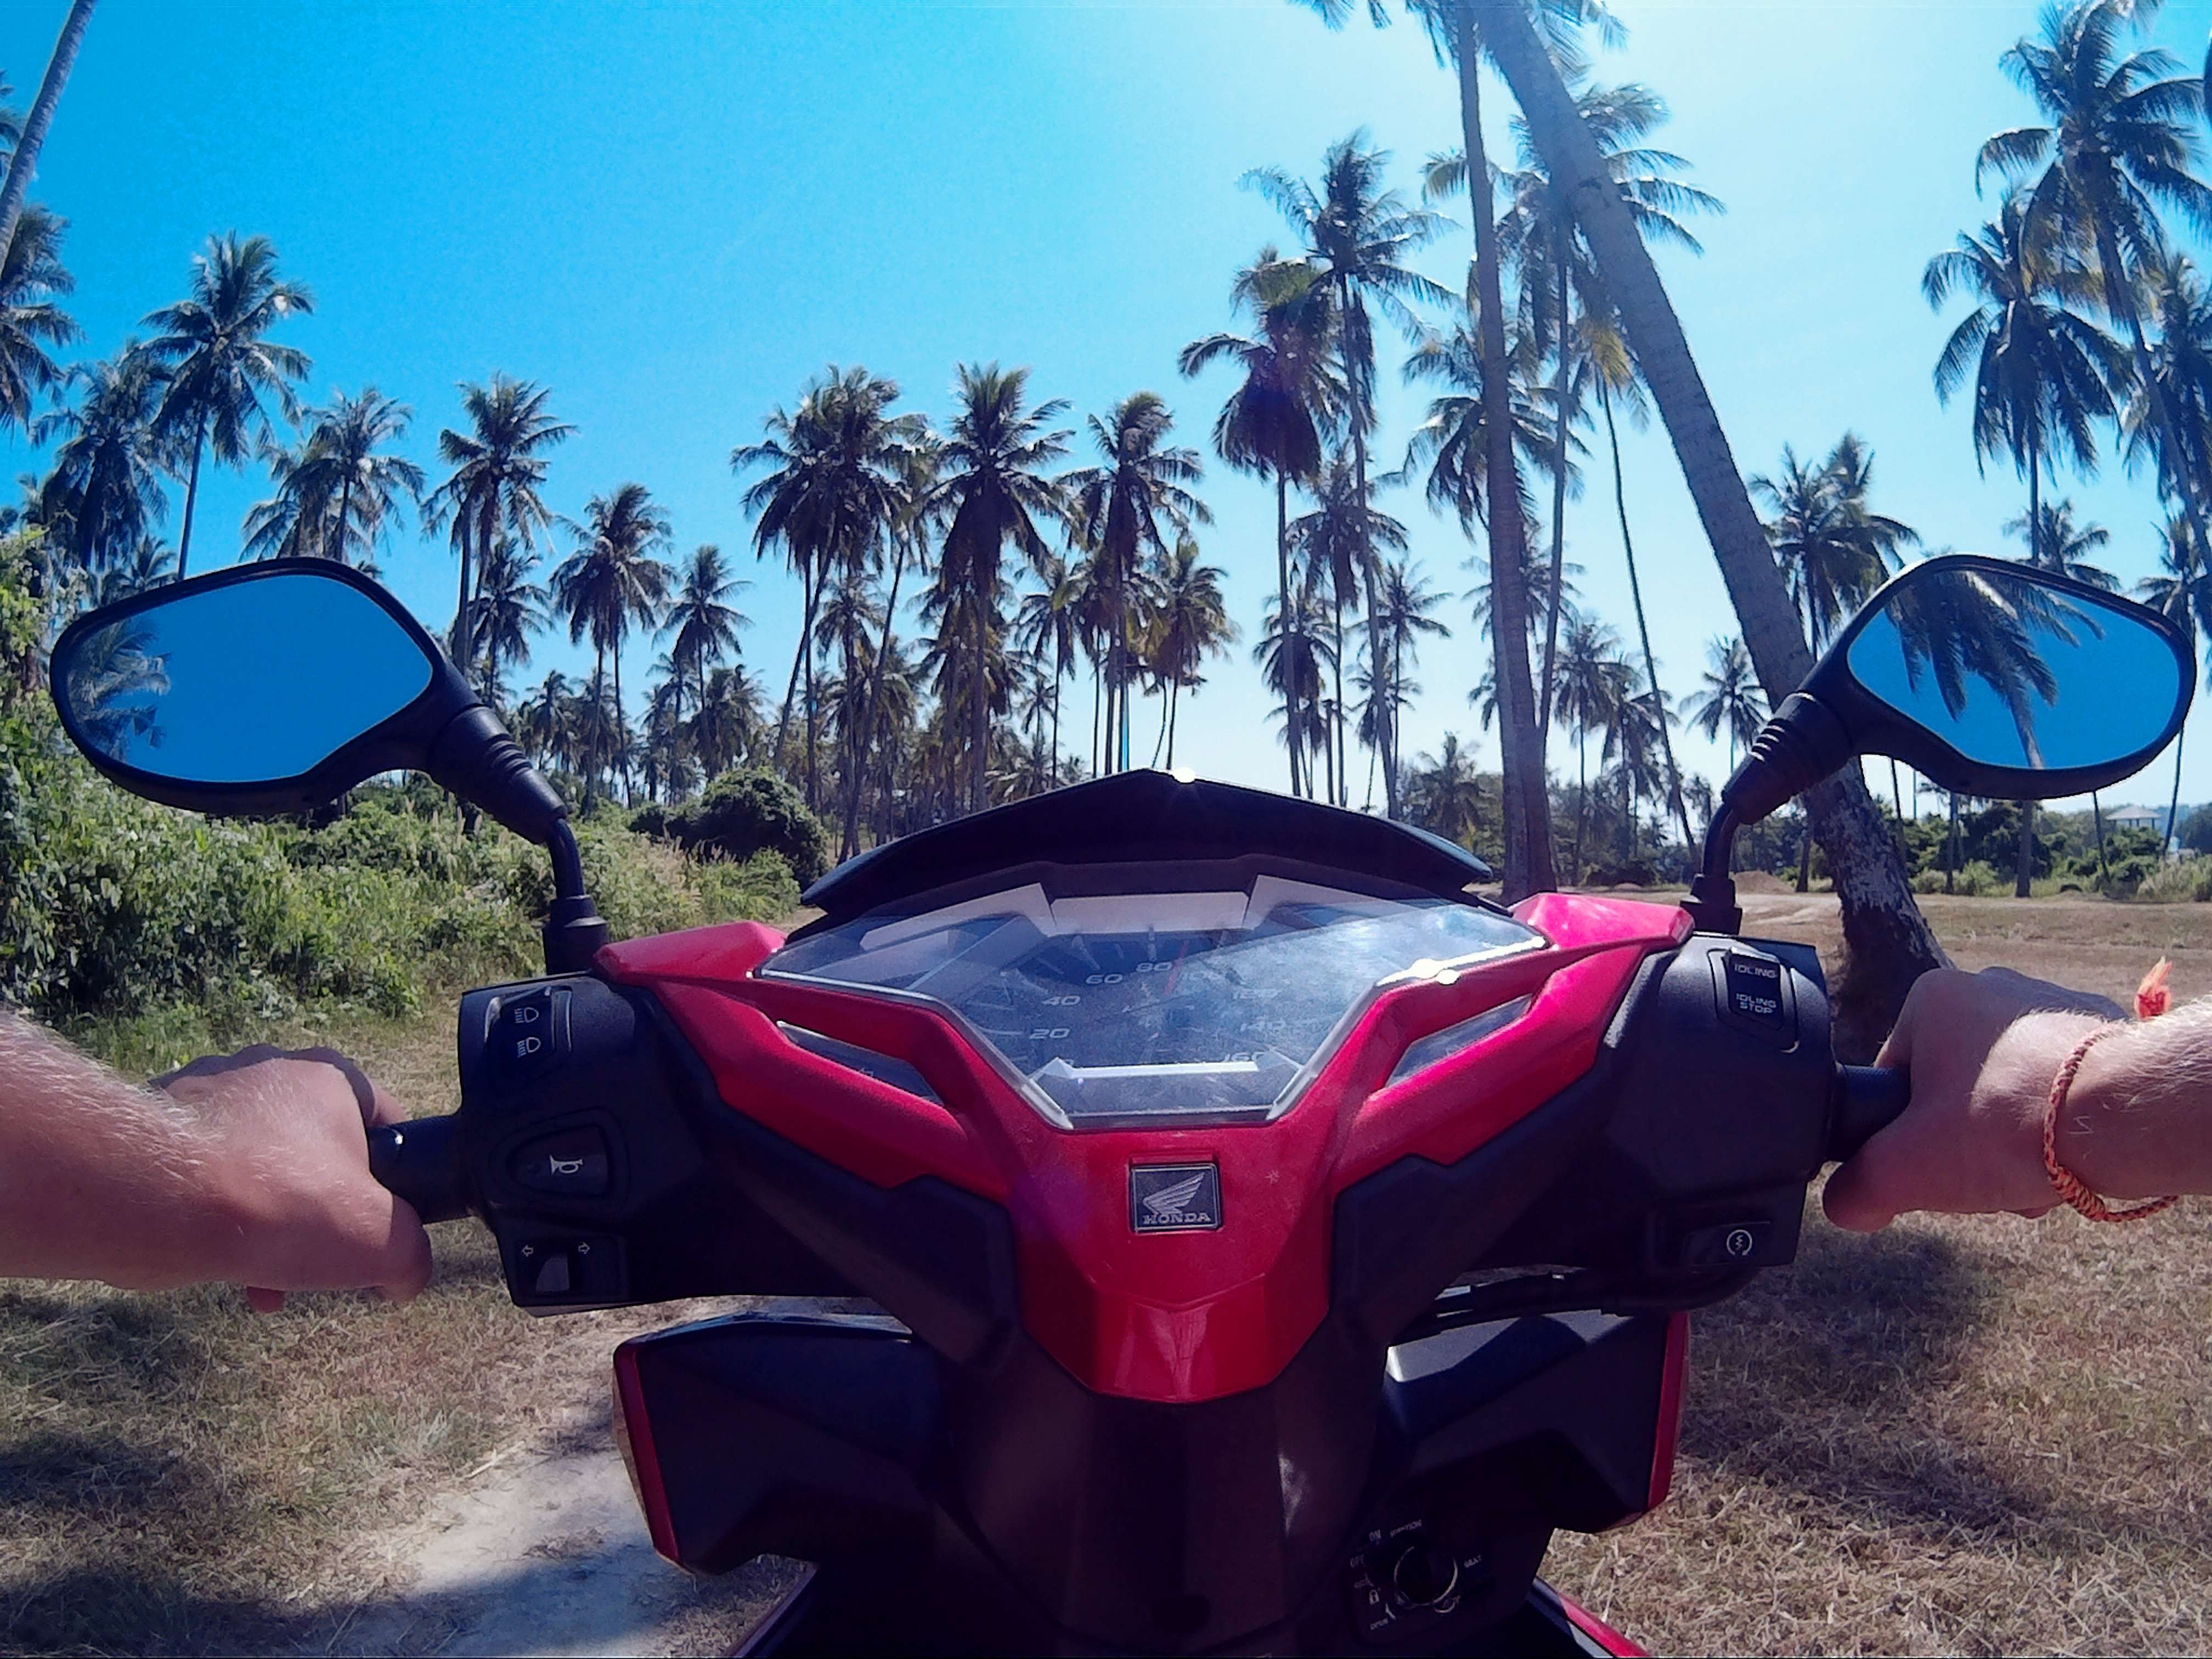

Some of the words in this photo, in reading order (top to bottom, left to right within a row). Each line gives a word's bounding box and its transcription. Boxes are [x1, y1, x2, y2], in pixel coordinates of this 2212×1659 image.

[1136, 962, 1173, 973] 80
[1734, 964, 1778, 978] IDLING
[1086, 974, 1123, 984] 60
[1041, 995, 1081, 1006] 40
[1736, 993, 1777, 1008] IDLING
[1740, 1002, 1773, 1013] STOP
[1029, 1028, 1070, 1040] 20
[1143, 1212, 1211, 1224] HONDA
